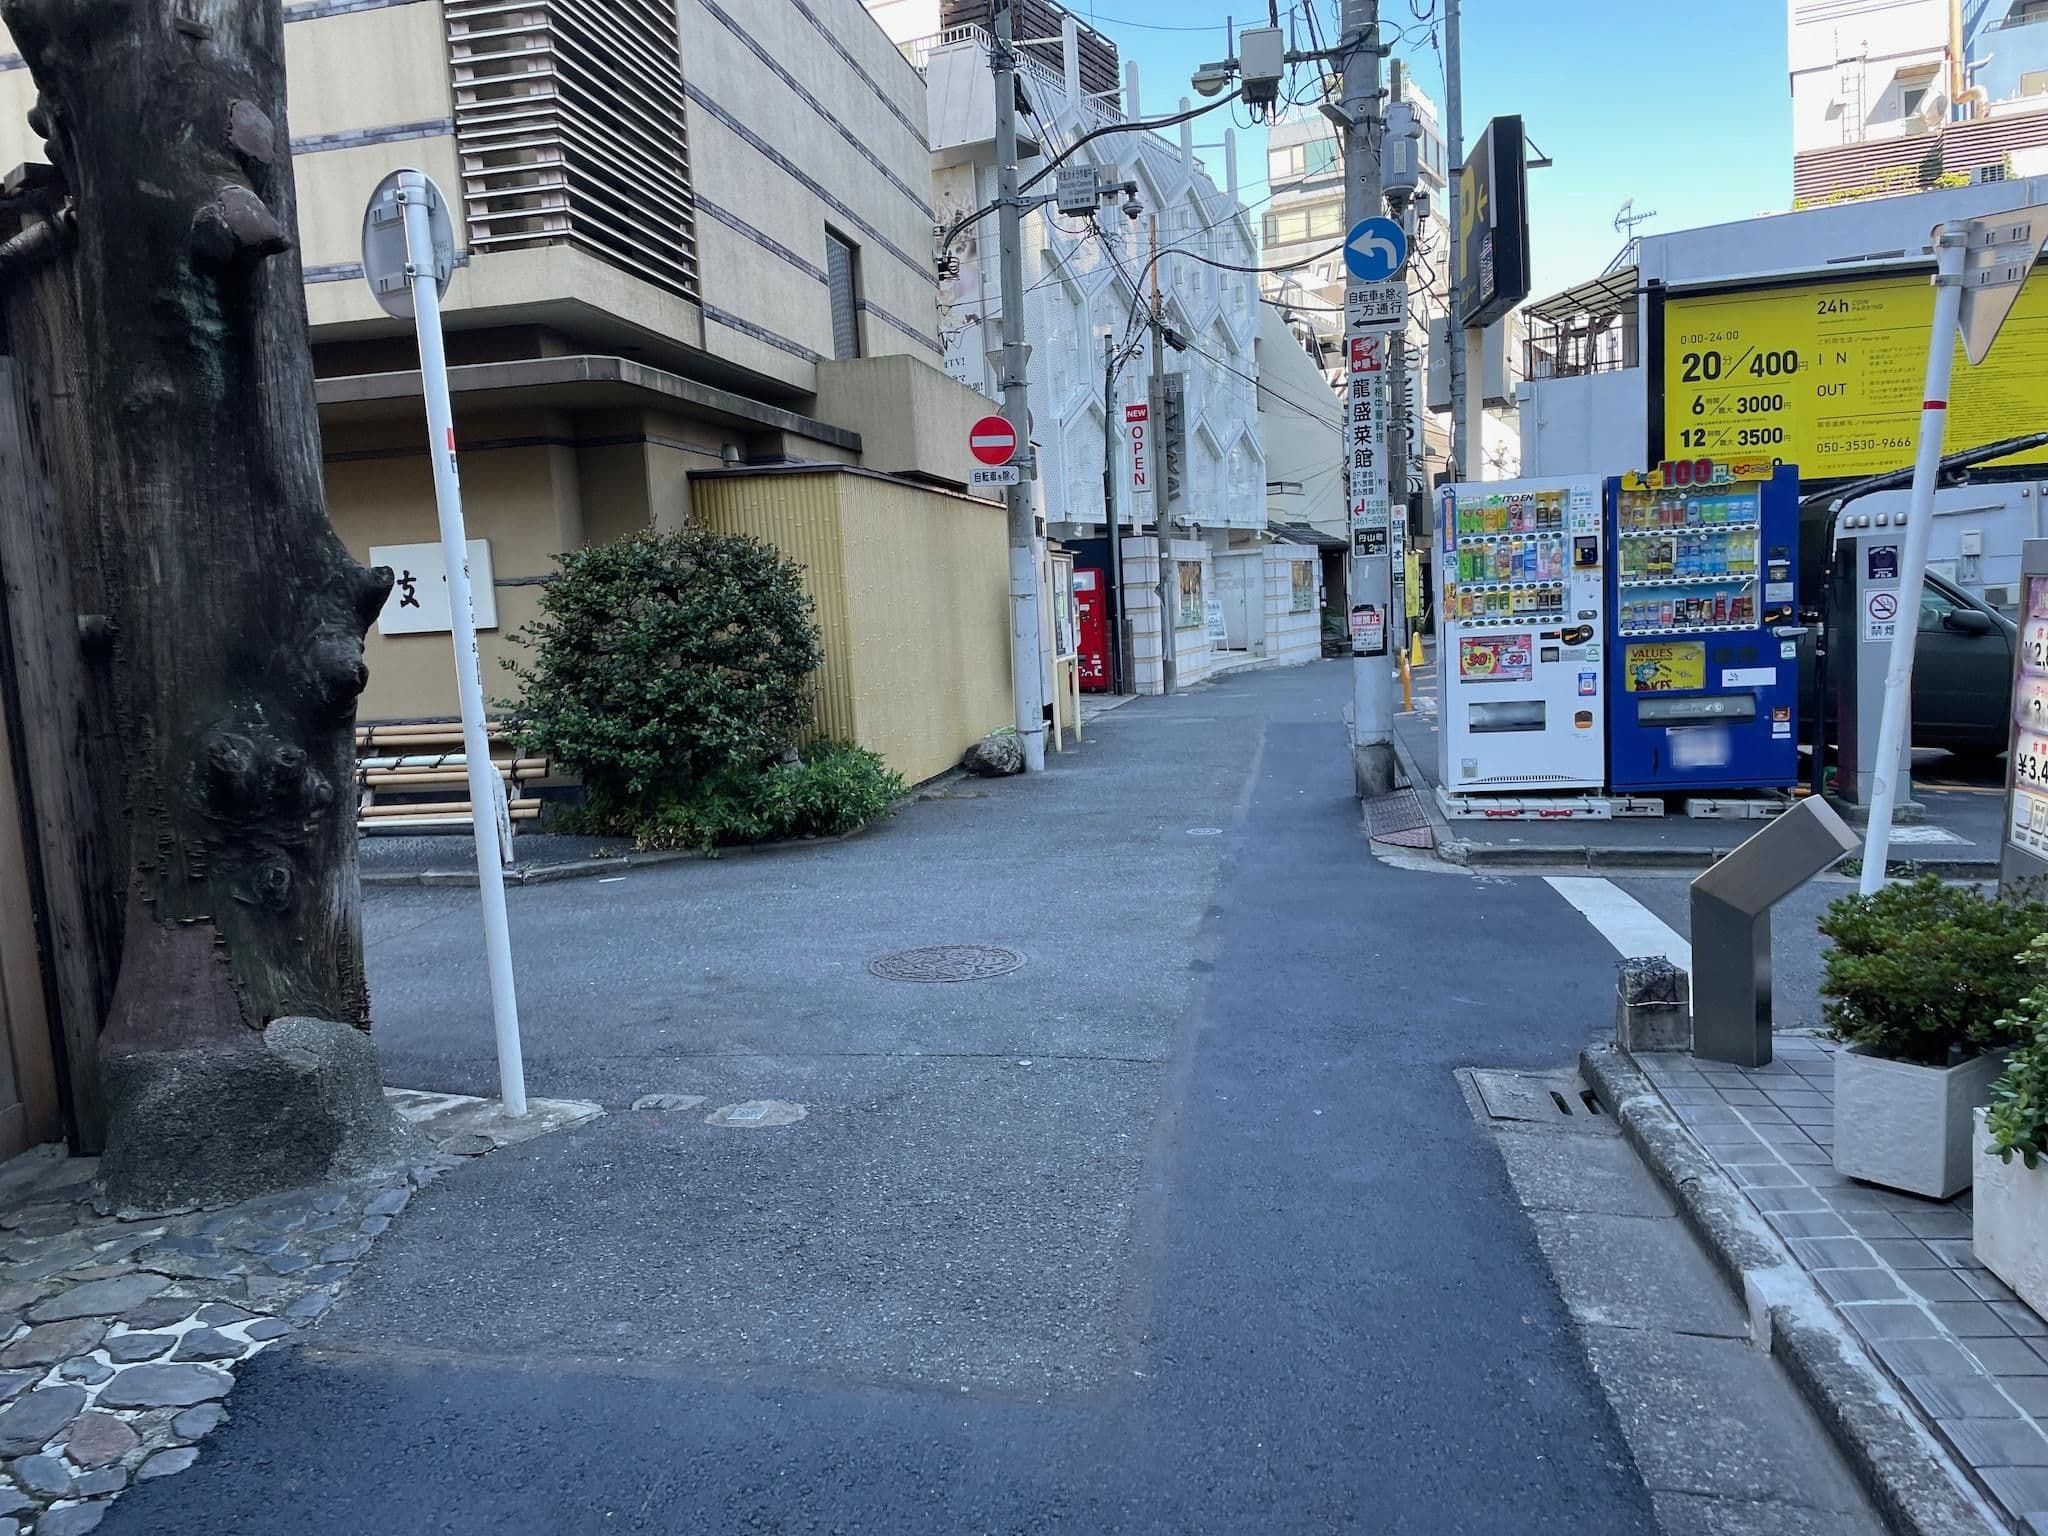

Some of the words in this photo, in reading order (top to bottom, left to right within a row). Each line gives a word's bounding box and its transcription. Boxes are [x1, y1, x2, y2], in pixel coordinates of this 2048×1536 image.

[1349, 288, 1402, 304] 自転車を除く
[1349, 301, 1403, 317] 一方通行
[1817, 298, 1849, 315] 24h
[1680, 330, 1739, 345] 0:00-24:00
[1817, 382, 1847, 397] OUT
[1127, 409, 1146, 418] NEW
[1352, 378, 1374, 469] 龍盛菜館
[1817, 437, 1911, 453] 050-3530-9666
[1132, 426, 1145, 486] OPEN
[974, 470, 1015, 483] 自転車を除く
[1502, 494, 1520, 503] ITO
[1520, 494, 1534, 502] EN
[1632, 648, 1673, 658] VALUES
